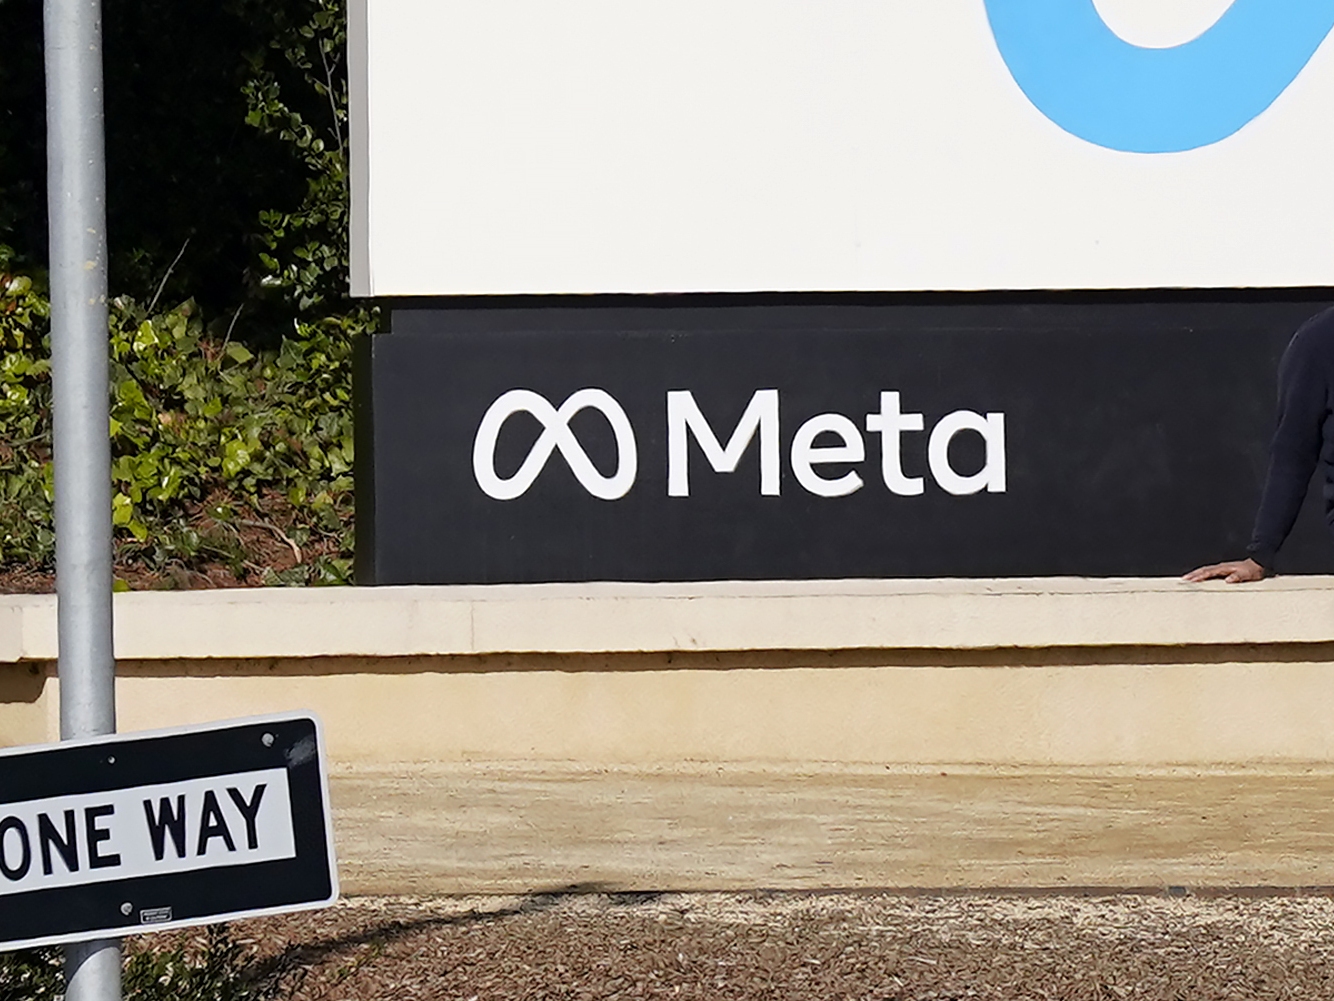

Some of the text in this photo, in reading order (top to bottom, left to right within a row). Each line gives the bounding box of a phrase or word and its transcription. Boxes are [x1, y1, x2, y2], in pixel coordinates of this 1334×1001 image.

[667, 389, 1007, 498] Meta
[0, 783, 267, 882] ONE WAY
